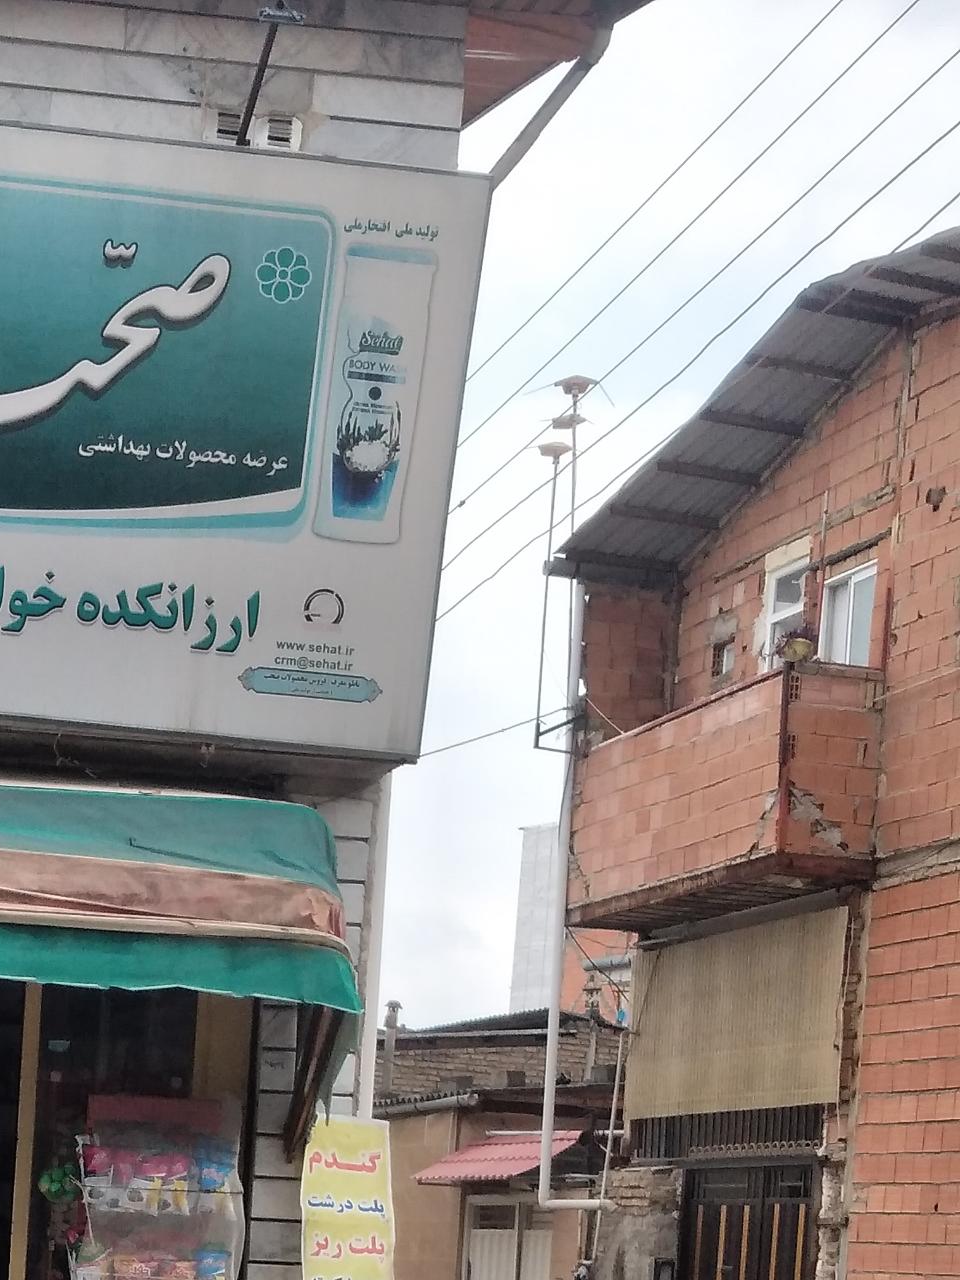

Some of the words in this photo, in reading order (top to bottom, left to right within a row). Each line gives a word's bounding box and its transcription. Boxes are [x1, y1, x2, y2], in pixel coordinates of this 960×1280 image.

[415, 224, 440, 242] تولید
[361, 330, 403, 348] Sehat
[348, 359, 376, 370] BODY
[78, 433, 150, 460] بهداشتی
[156, 439, 237, 468] محصولات
[242, 450, 288, 476] عرضه
[77, 582, 261, 653] ارزانکده
[275, 640, 355, 656] www.sehat.ir
[274, 656, 354, 671] crm@sehat.ir
[308, 1150, 381, 1174] گندم
[307, 1194, 353, 1213] درشت
[357, 1199, 386, 1218] پلت
[310, 1232, 342, 1258] ریز
[348, 1235, 385, 1262] پلت
